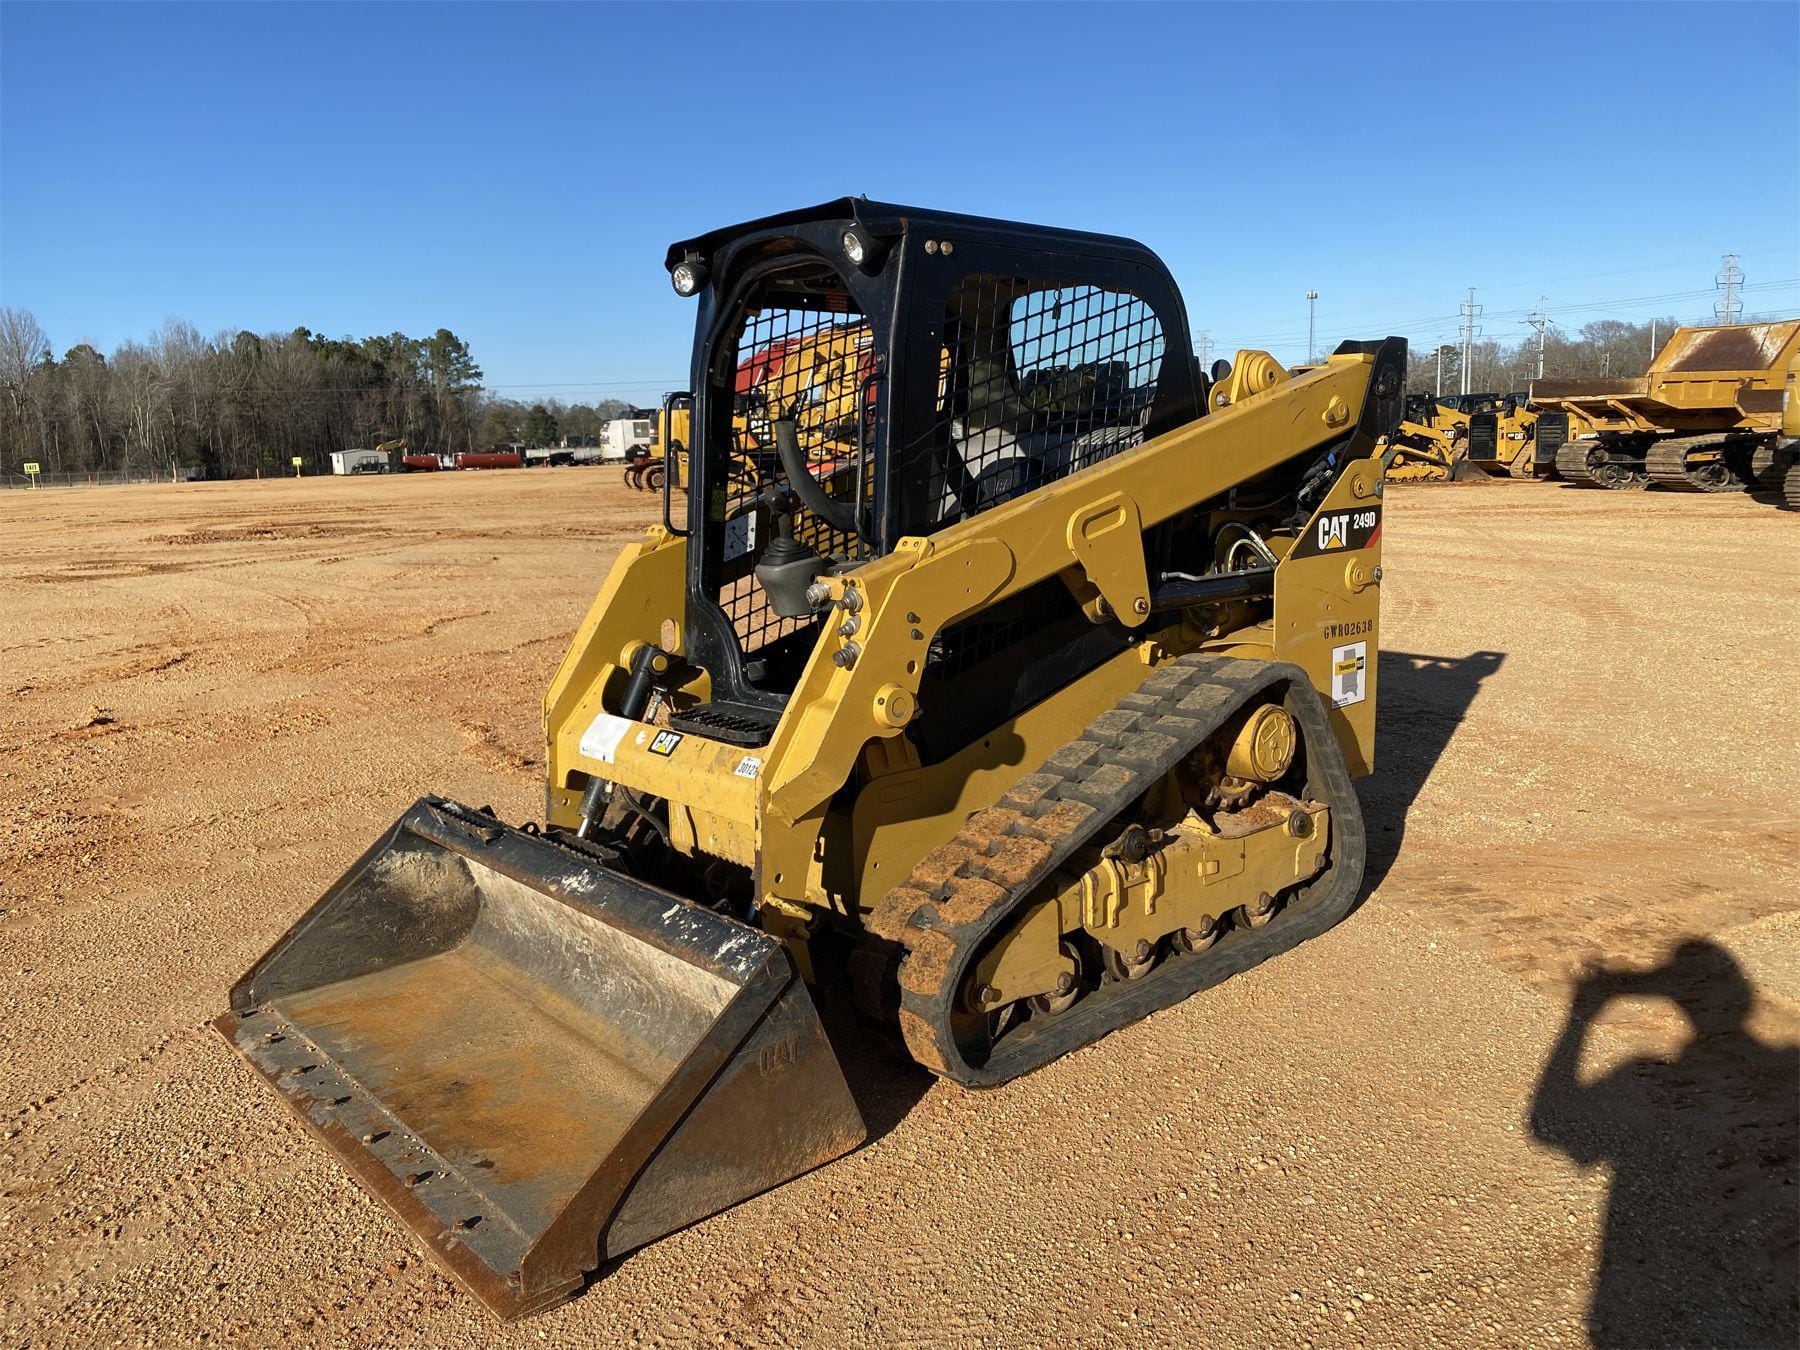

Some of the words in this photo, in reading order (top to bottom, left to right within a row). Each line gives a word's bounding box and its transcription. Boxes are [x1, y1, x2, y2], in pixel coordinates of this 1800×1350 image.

[1318, 514, 1350, 550] CAT
[1353, 511, 1376, 529] 249D
[1324, 619, 1373, 640] GWR02638
[651, 731, 681, 755] CAT
[760, 1038, 798, 1077] CAT
